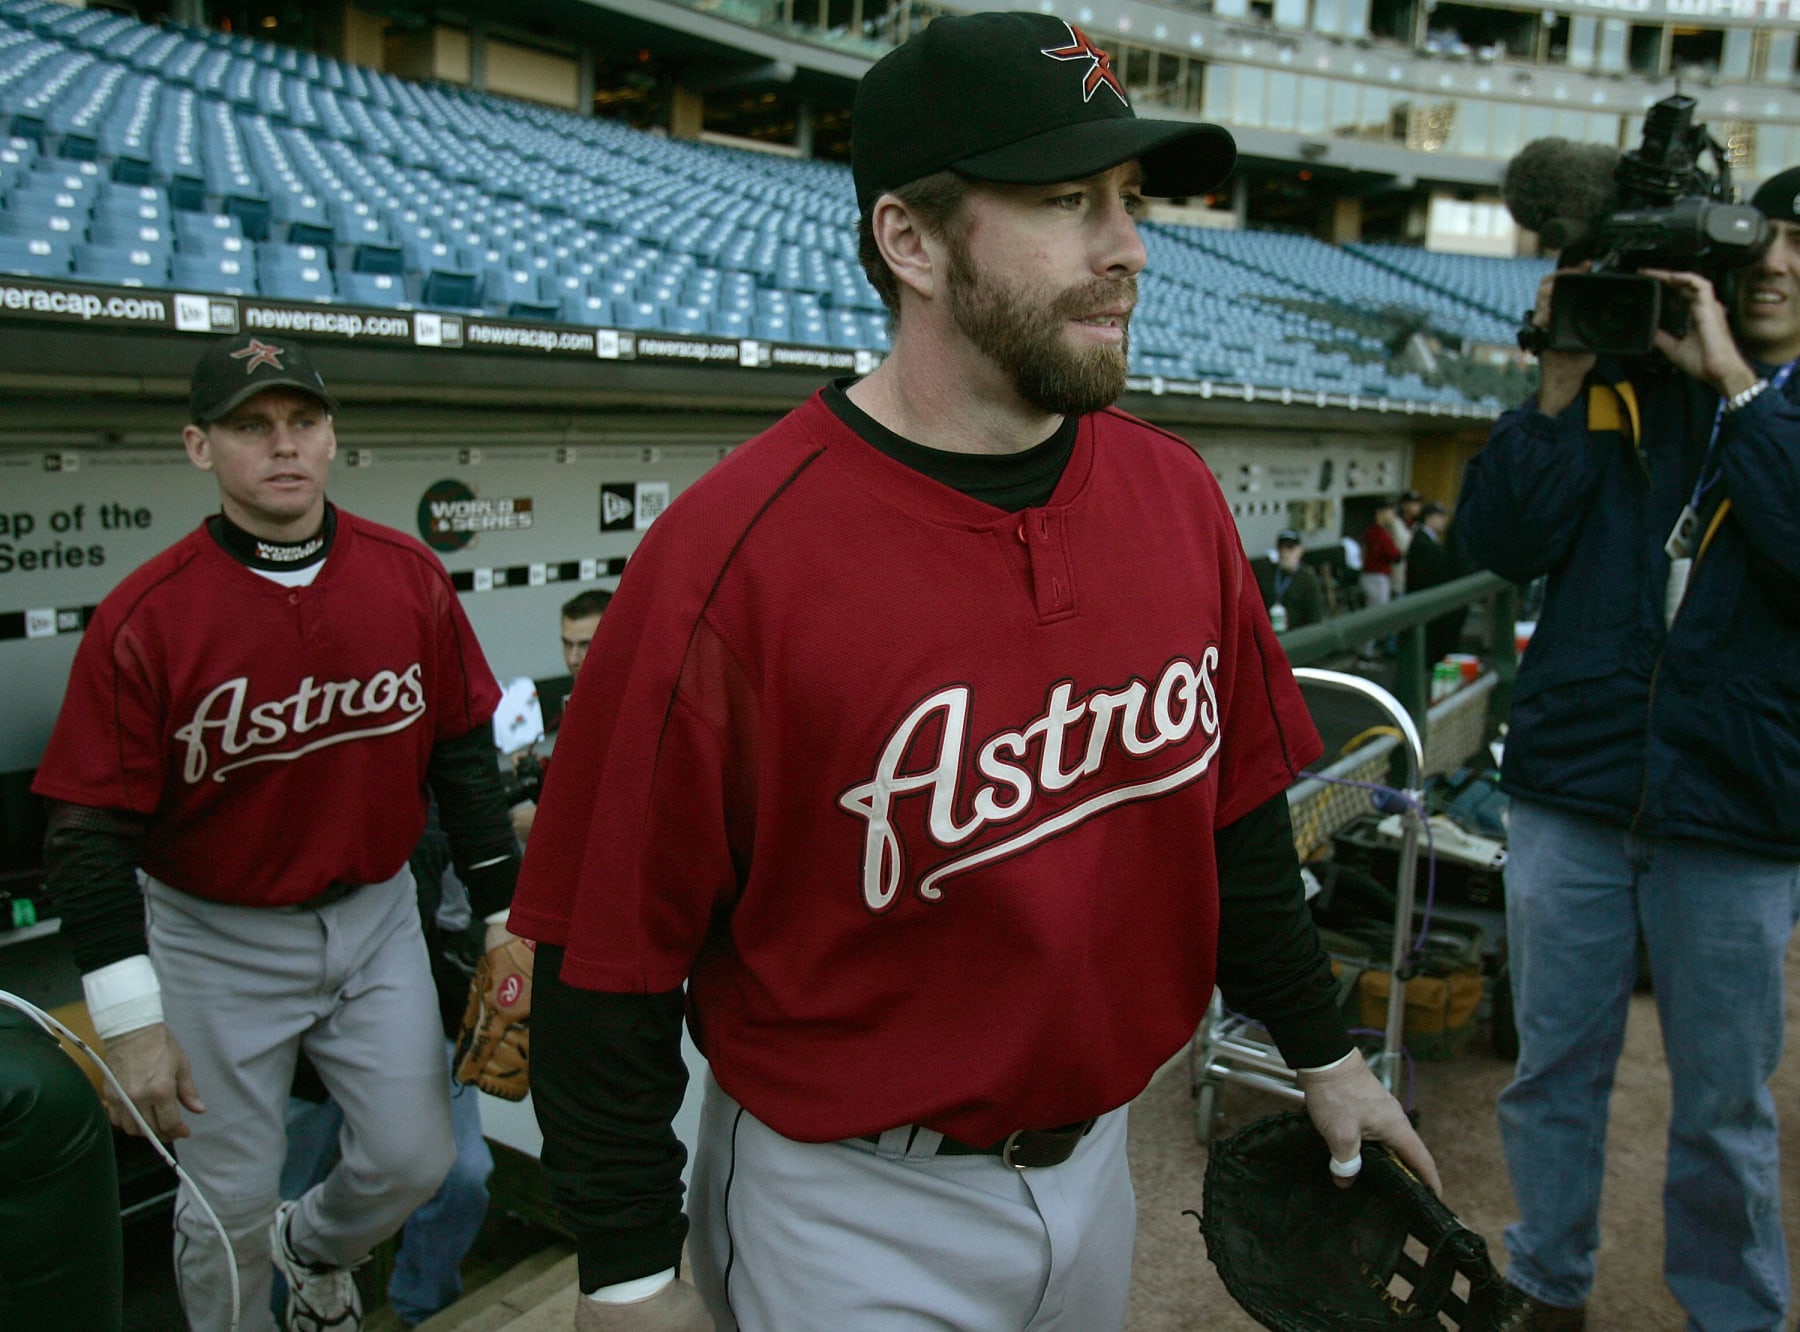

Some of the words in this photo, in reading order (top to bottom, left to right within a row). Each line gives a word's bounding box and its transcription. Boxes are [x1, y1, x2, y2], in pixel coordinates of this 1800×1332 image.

[0, 287, 165, 321] eracap.com
[245, 307, 409, 337] neweracap.com
[468, 323, 594, 351] neweracap.com
[638, 338, 738, 362] neweracap.com
[773, 348, 854, 369] neweracap.com
[50, 503, 84, 533] of
[101, 502, 152, 530] the
[431, 498, 513, 517] WORLD
[452, 512, 532, 532] SERIES
[0, 541, 104, 573] Series
[175, 663, 426, 783] Astros
[840, 647, 1220, 908] Astros
